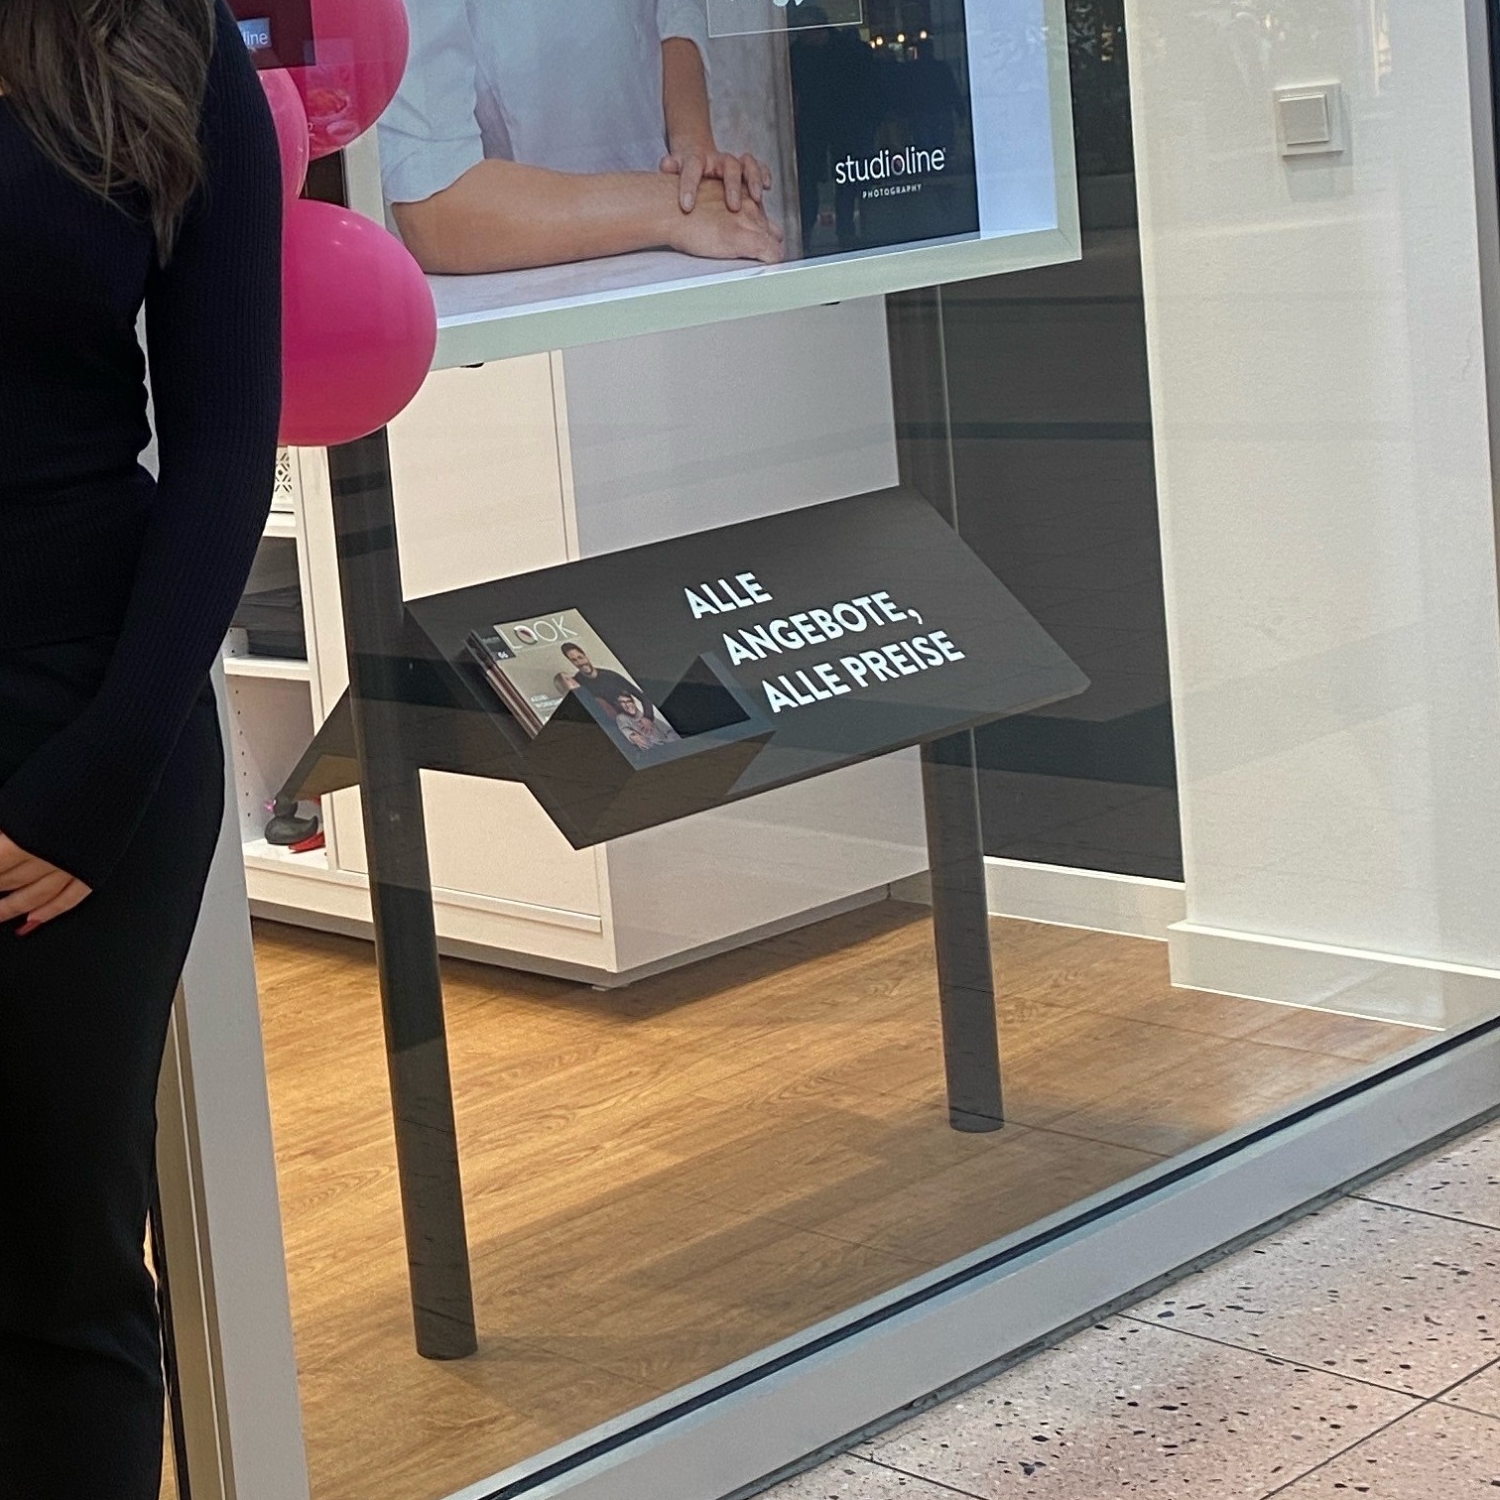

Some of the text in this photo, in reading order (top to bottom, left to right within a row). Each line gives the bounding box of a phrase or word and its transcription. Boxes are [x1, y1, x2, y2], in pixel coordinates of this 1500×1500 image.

[835, 146, 945, 184] studioline
[862, 184, 921, 198] PHOTOGRAPHY
[683, 573, 772, 618] ALLE
[499, 615, 577, 649] LOOK
[722, 590, 922, 665] ANGEBOTE,
[761, 631, 964, 712] ALLE PREISE
